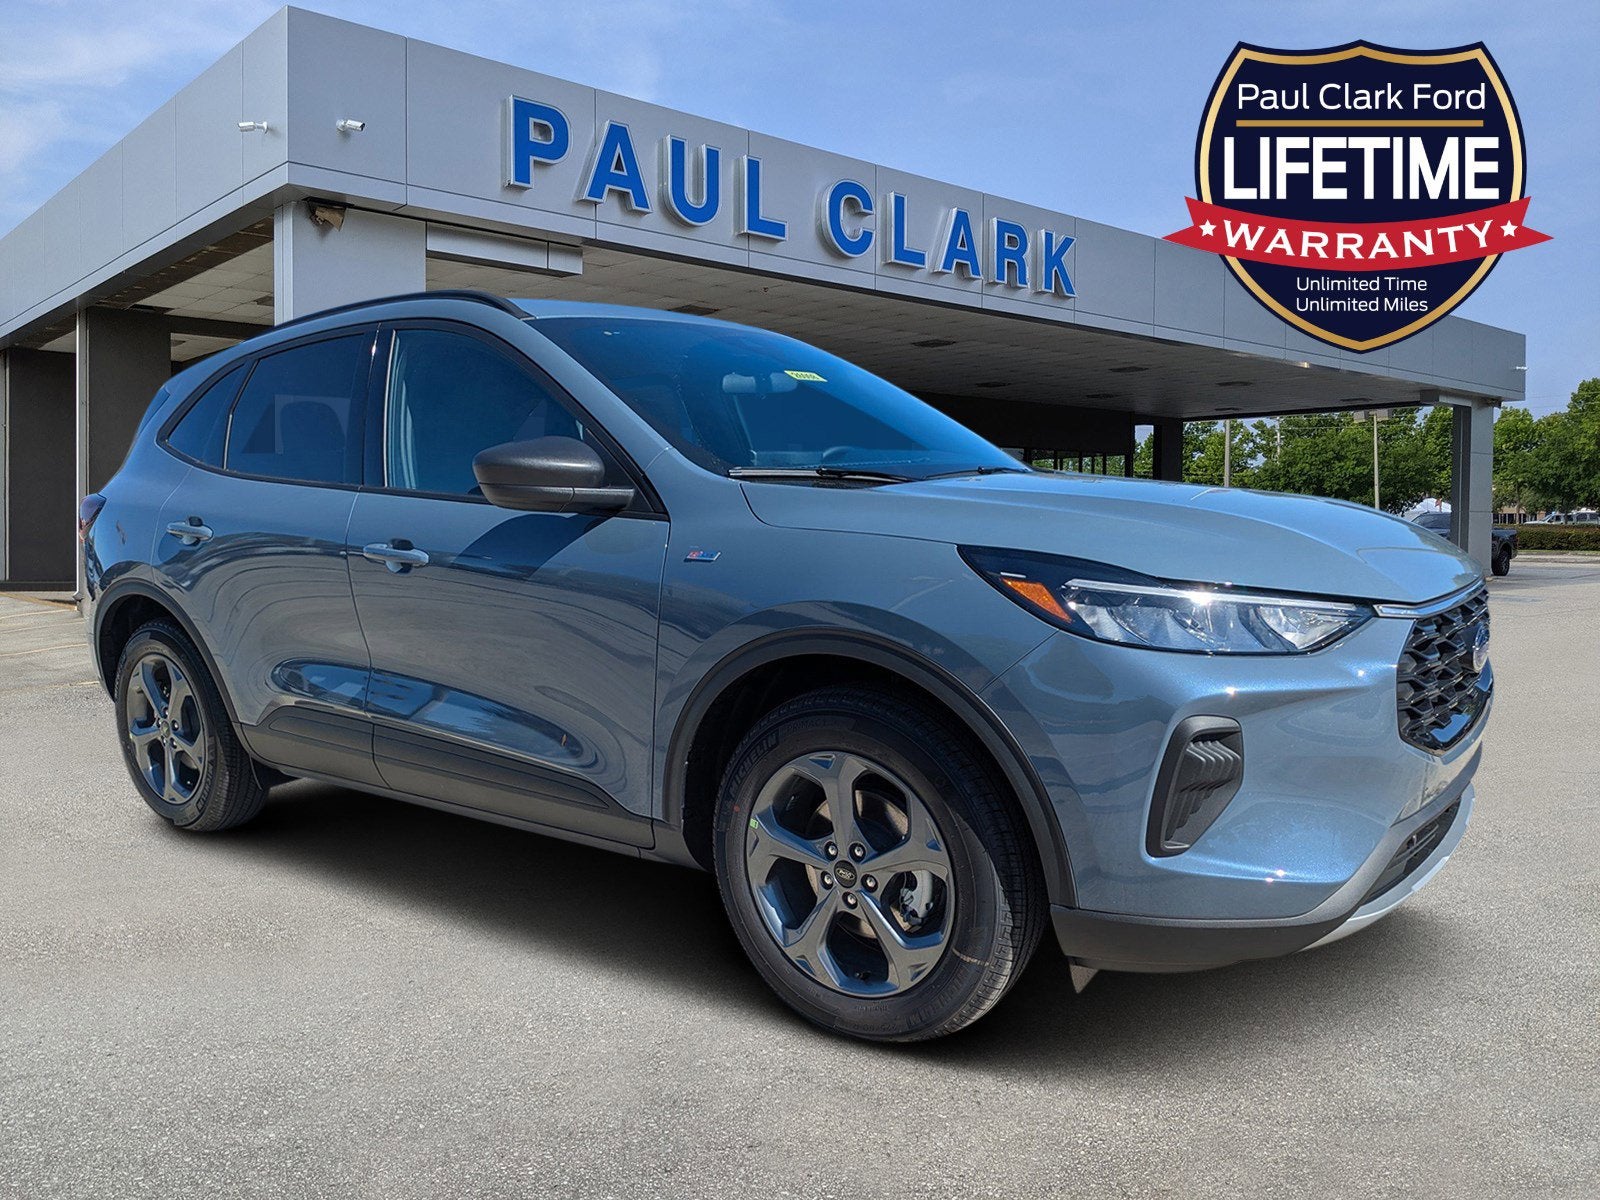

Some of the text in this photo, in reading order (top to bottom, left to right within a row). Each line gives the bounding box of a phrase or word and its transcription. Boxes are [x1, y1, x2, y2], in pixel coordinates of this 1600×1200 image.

[509, 96, 1077, 297] PAUL CLARK
[729, 732, 779, 798] MICHELIN
